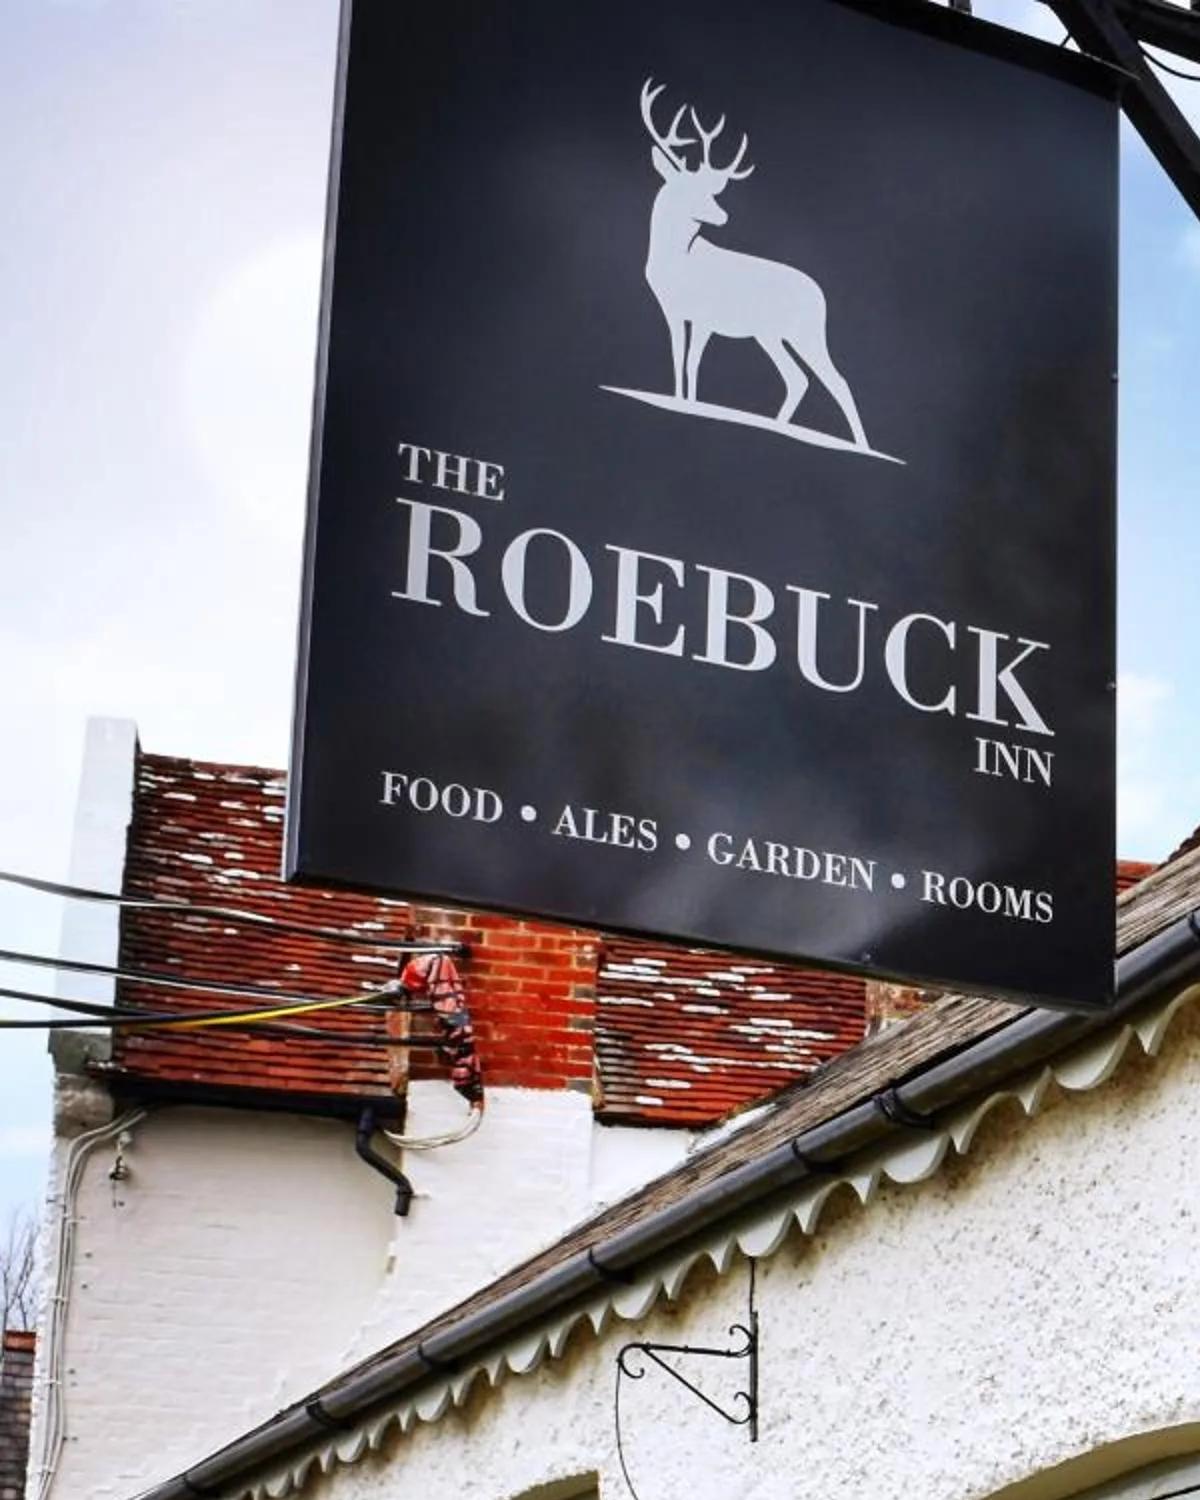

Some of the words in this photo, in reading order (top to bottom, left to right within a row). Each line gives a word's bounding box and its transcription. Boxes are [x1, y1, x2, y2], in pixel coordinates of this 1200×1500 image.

[398, 442, 506, 502] THE
[390, 496, 1057, 737] ROEBUCK
[973, 736, 1055, 788] INN
[380, 771, 504, 824] FOOD
[551, 803, 660, 853] ALES
[706, 830, 878, 893] GARDEN
[921, 870, 1055, 924] ROOMS
